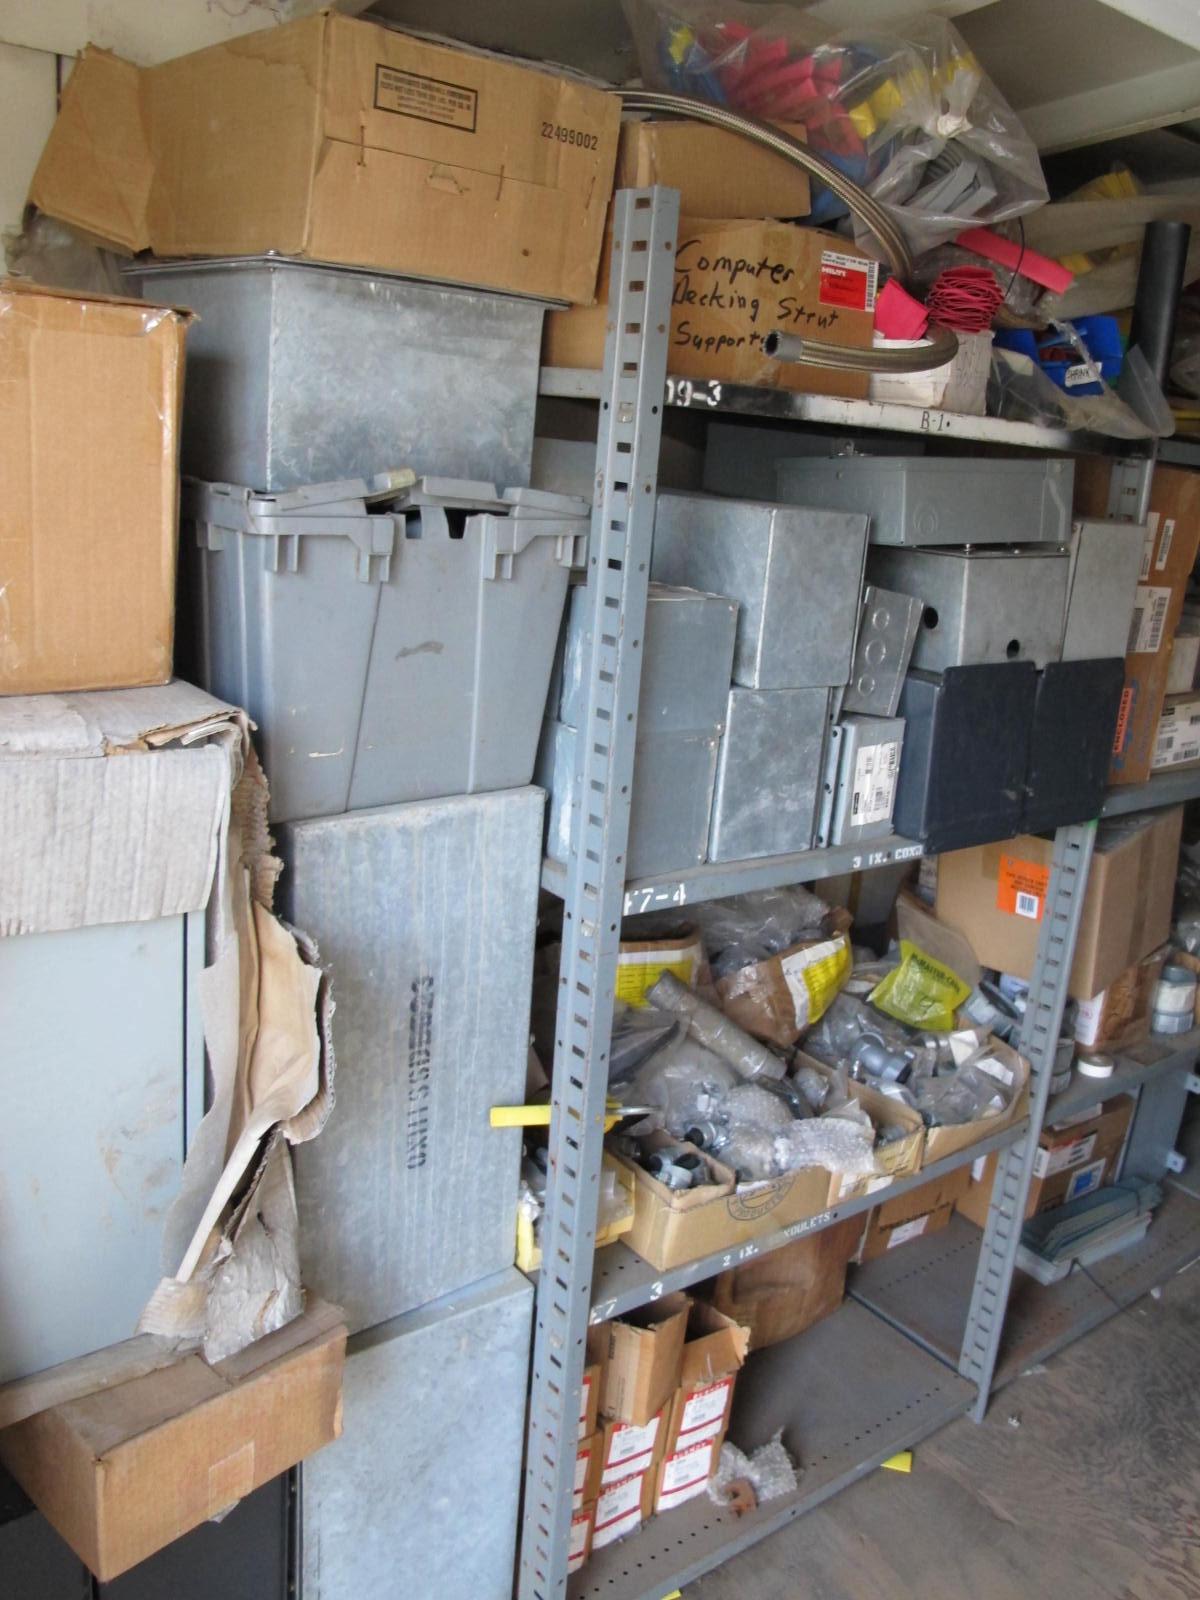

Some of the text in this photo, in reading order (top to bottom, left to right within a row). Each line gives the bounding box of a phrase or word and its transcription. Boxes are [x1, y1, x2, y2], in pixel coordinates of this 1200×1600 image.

[541, 121, 598, 151] 22499002
[675, 239, 795, 285] Computer
[672, 274, 839, 329] Decking Strut
